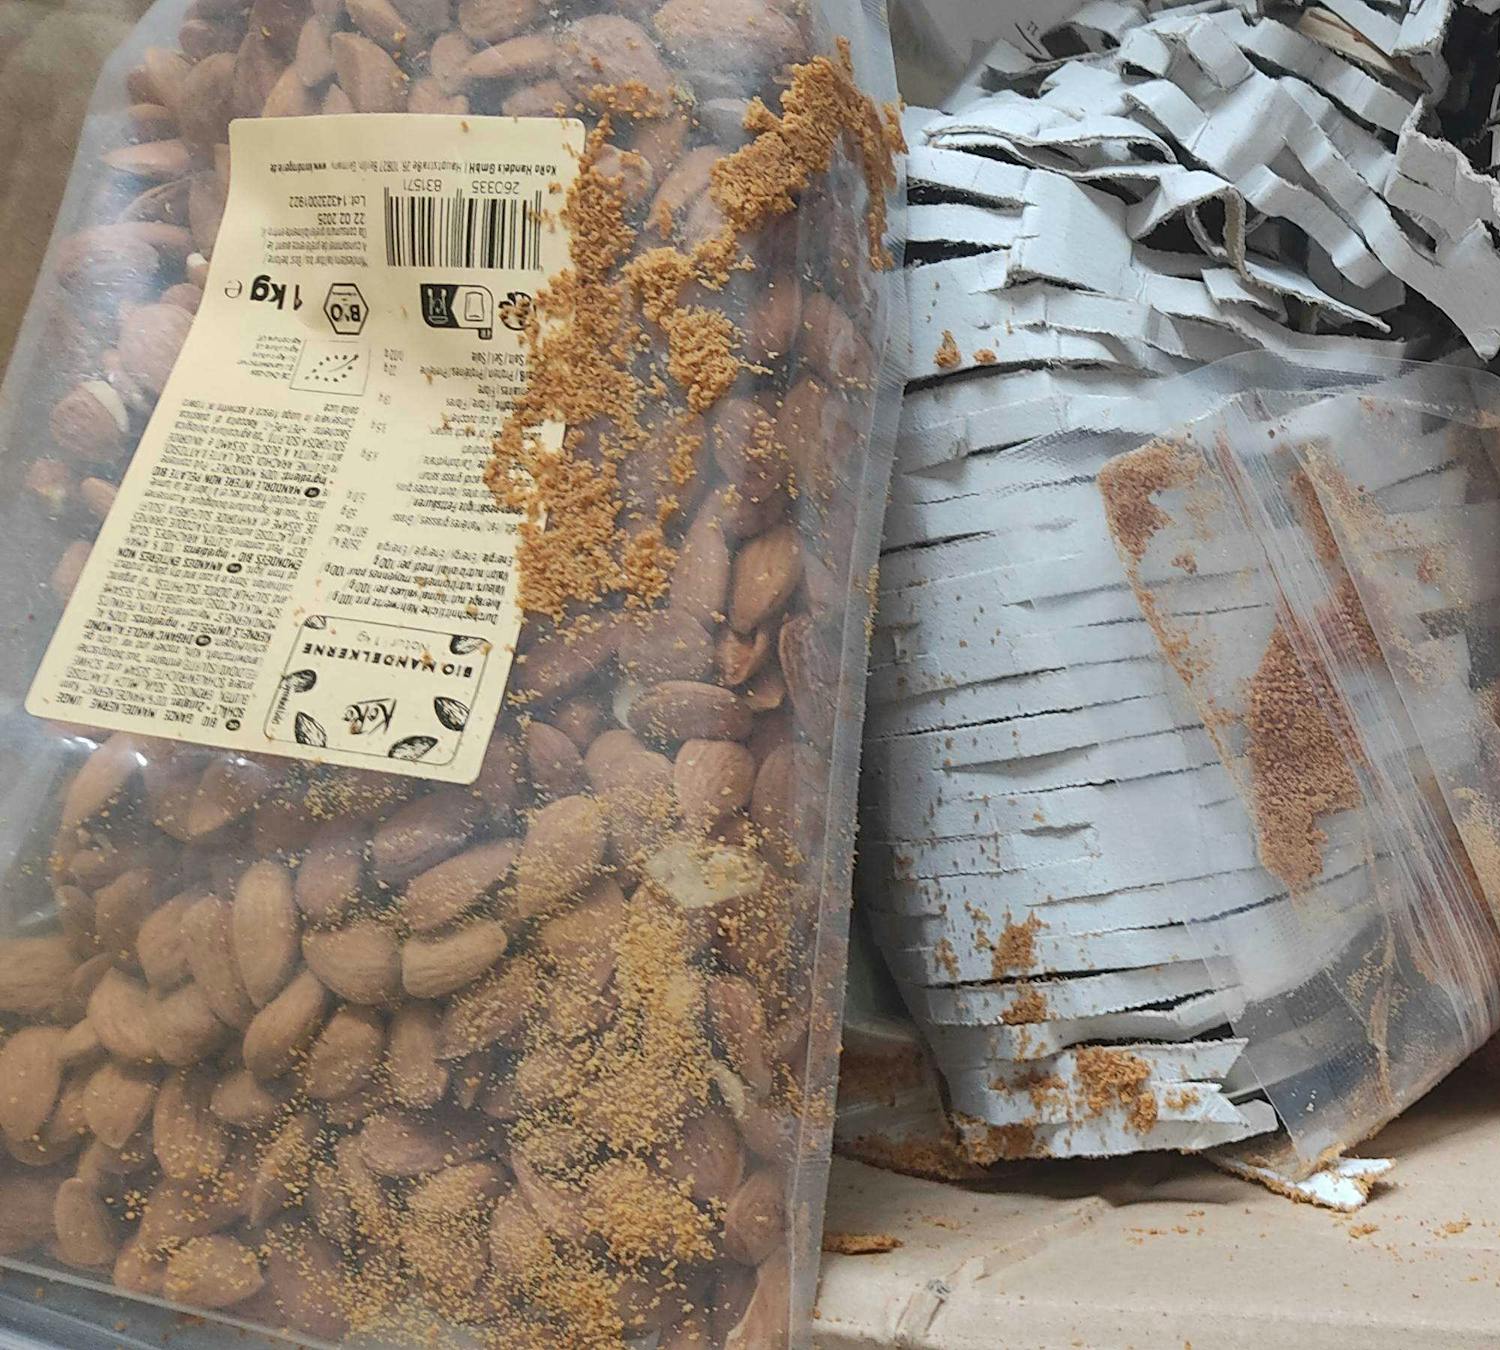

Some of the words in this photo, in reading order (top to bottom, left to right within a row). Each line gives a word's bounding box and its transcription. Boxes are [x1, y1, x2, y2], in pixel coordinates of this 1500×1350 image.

[468, 162, 495, 174] GmbH
[497, 163, 531, 175] Handels
[534, 164, 556, 175] KoRo
[402, 178, 441, 191] 831571
[471, 180, 519, 194] 260335
[249, 274, 286, 309] kg
[293, 284, 302, 310] 1
[470, 351, 486, 364] Sale
[492, 352, 503, 365] Sel
[507, 353, 524, 366] Salt
[167, 468, 203, 481] PELATE
[201, 473, 224, 484] NON
[222, 475, 254, 489] INTERE
[253, 479, 303, 495] MANDORLE
[115, 547, 137, 558] NON
[237, 551, 254, 562] BIO
[302, 642, 436, 672] MANDELKERNE
[441, 662, 472, 677] BIO
[88, 697, 157, 718] MANDELKERNE
[162, 709, 194, 724] GANZE
[199, 715, 218, 728] BIO
[342, 699, 396, 735] KoRo
